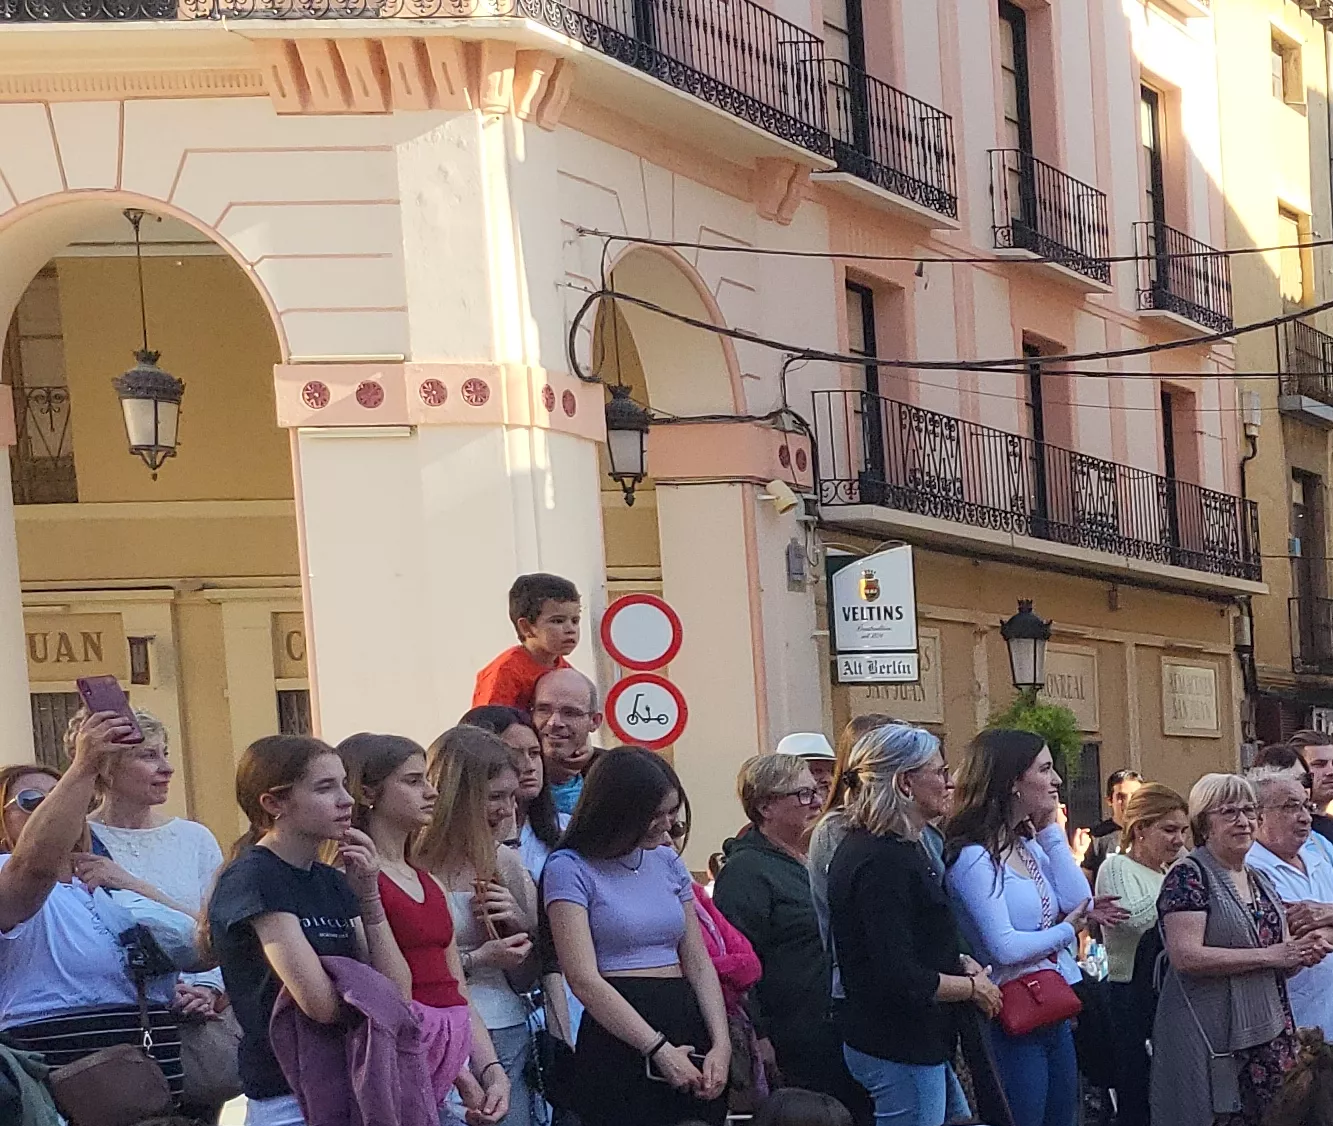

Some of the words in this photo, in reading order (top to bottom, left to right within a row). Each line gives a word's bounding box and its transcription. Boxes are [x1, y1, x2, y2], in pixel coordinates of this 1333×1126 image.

[842, 606, 904, 621] VELTINS
[26, 631, 104, 664] UAN
[285, 630, 307, 662] C
[843, 660, 863, 676] Alt
